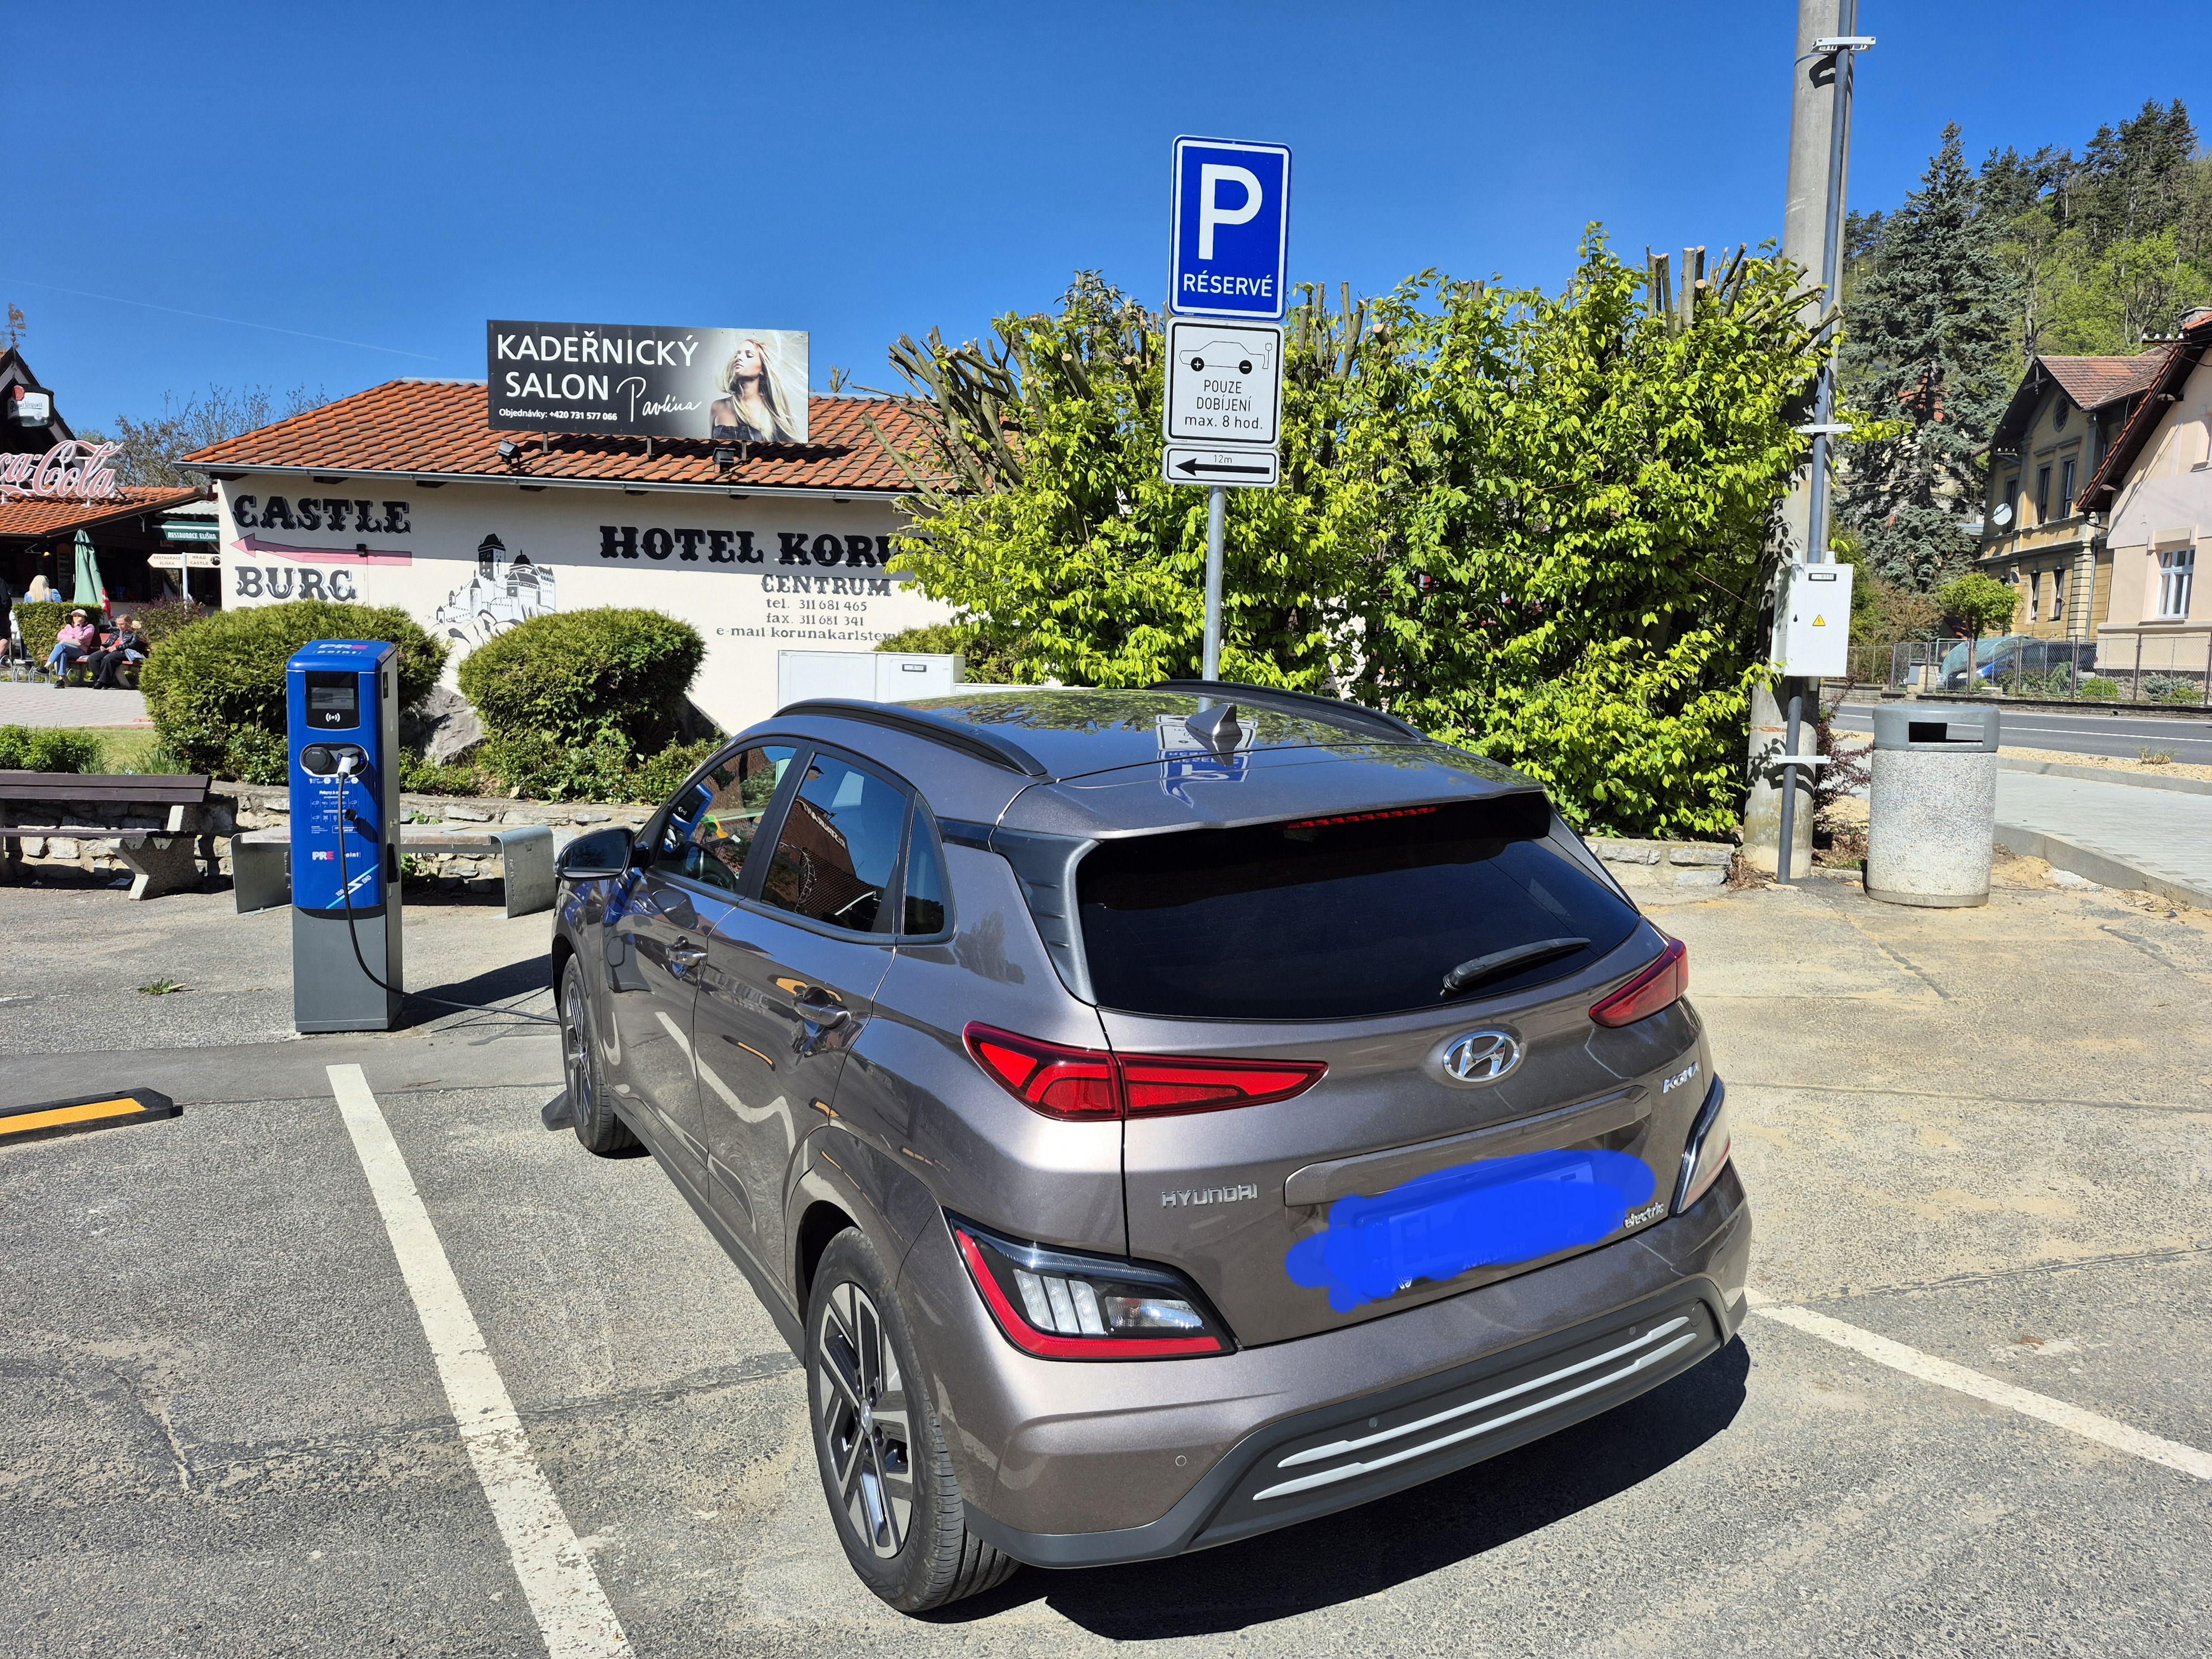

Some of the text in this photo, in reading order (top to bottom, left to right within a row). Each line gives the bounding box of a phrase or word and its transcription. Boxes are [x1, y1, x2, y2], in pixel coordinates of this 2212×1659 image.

[1198, 163, 1262, 260] P
[1183, 269, 1273, 297] RÉSERVÉ
[498, 331, 699, 367] KADEŘNICKÝ
[505, 371, 608, 400] SALON
[1204, 379, 1242, 394] POUZE
[499, 408, 618, 421] Objednávky: +420 731 577 066
[1197, 394, 1251, 412] DOBÍJENÍ
[1185, 415, 1262, 429] max. 8 hod.
[1214, 455, 1232, 463] 12m
[233, 494, 411, 534] CASTLE
[599, 525, 764, 564] HOTEL
[761, 574, 892, 597] CENTRUM
[766, 598, 790, 609] tel.
[766, 613, 794, 624] fax.
[312, 851, 335, 860] PRE
[1663, 1061, 1699, 1094] KONA
[1161, 1183, 1258, 1208] HYUNDAI
[1624, 1201, 1664, 1228] electric
